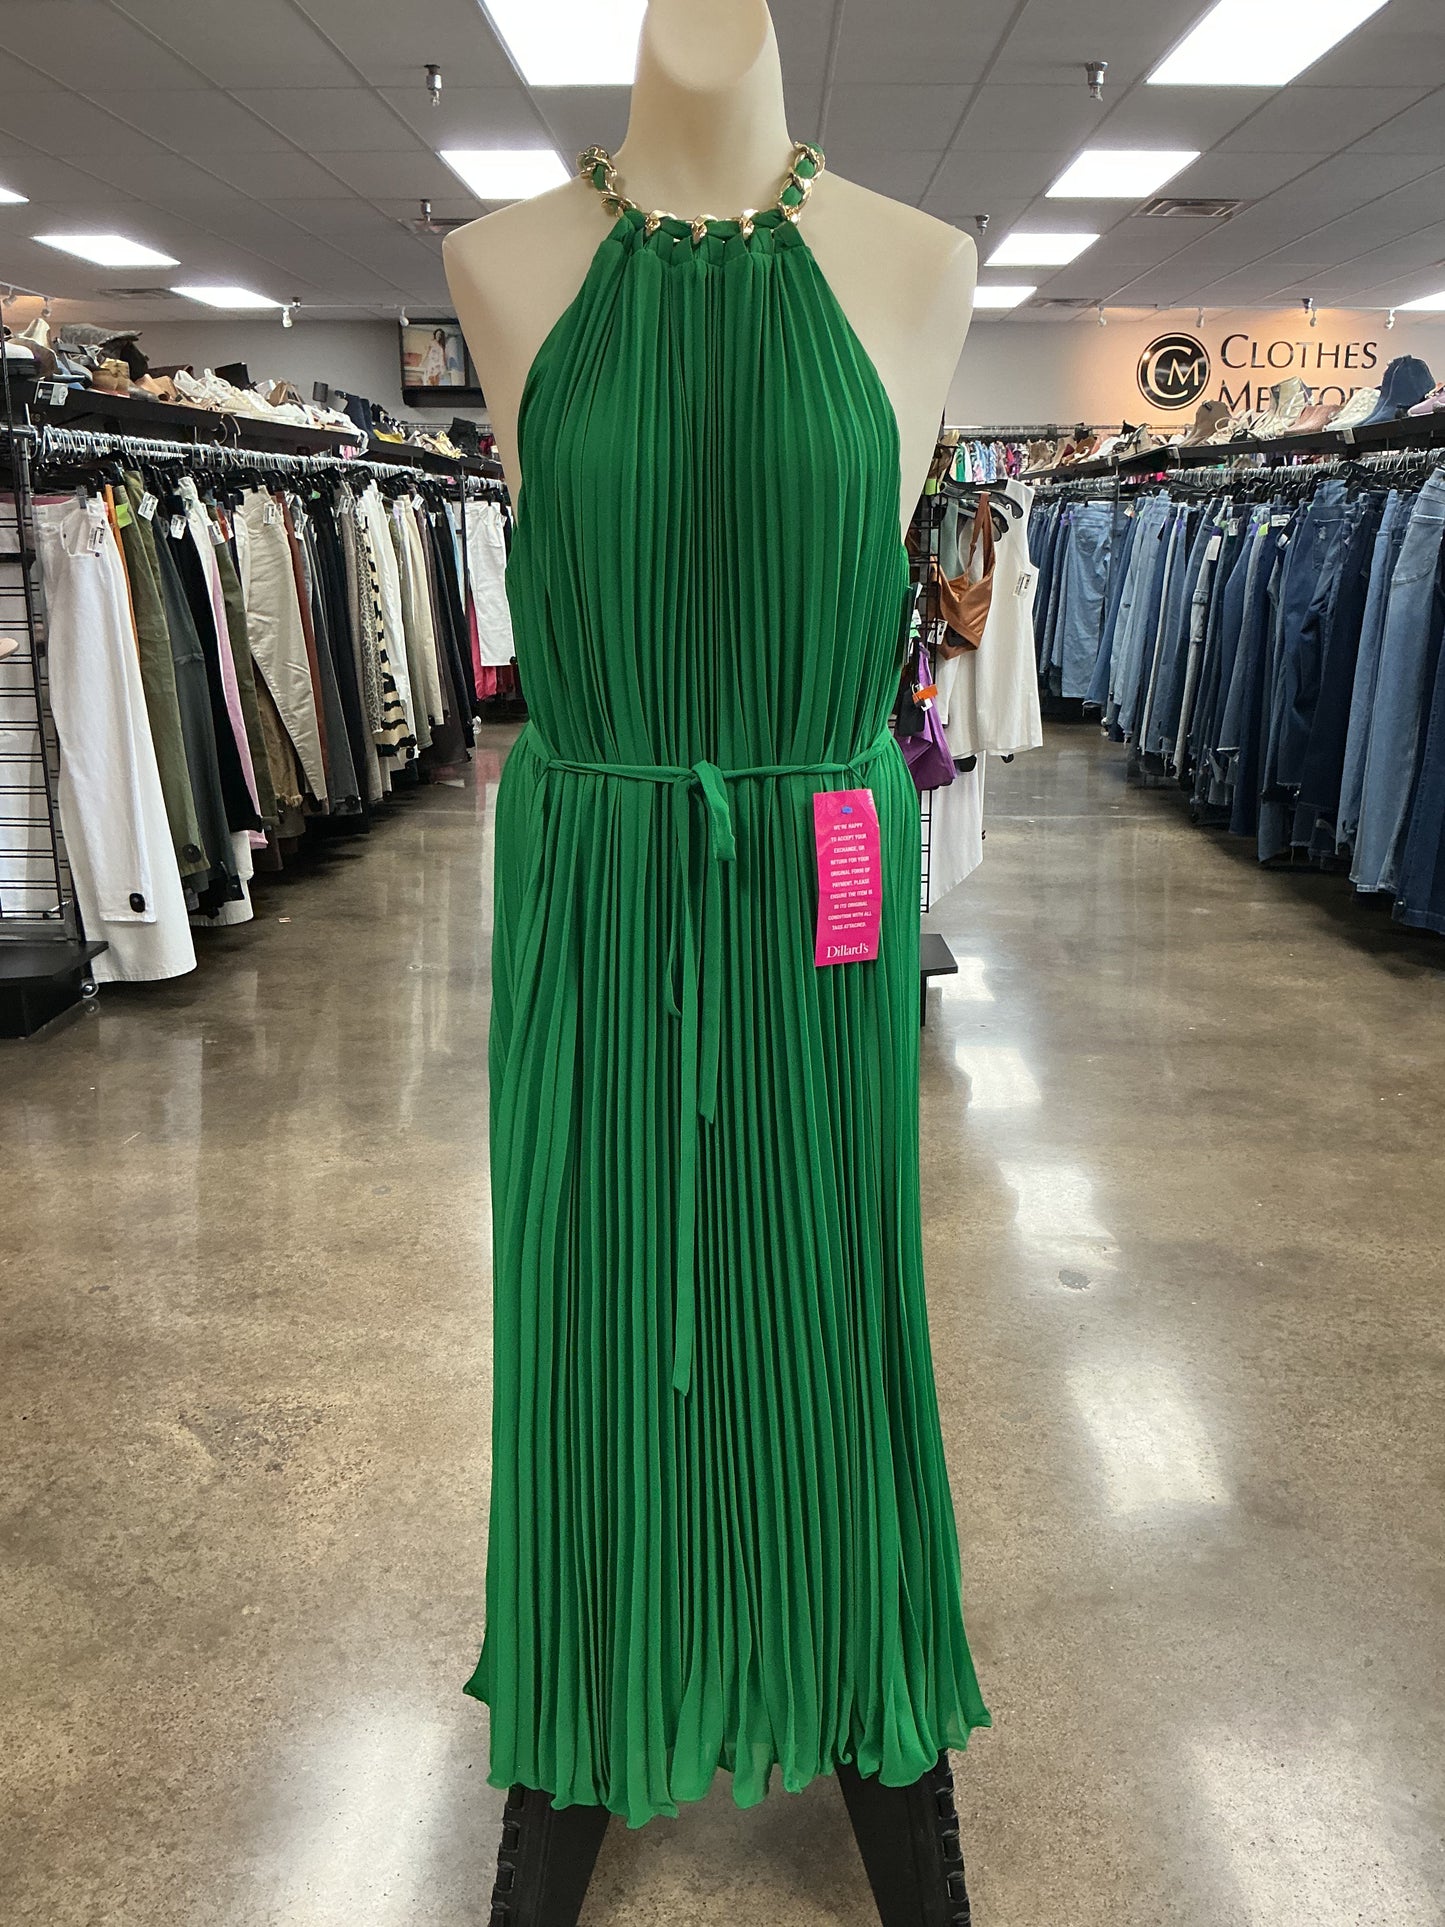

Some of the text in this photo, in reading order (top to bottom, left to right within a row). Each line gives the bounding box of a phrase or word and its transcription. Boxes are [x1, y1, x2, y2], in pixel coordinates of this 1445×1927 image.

[1220, 334, 1377, 368] CLOTHES
[830, 892, 847, 900] ENSURE
[828, 913, 852, 921] CONDITION
[826, 942, 869, 958] Dillard's
